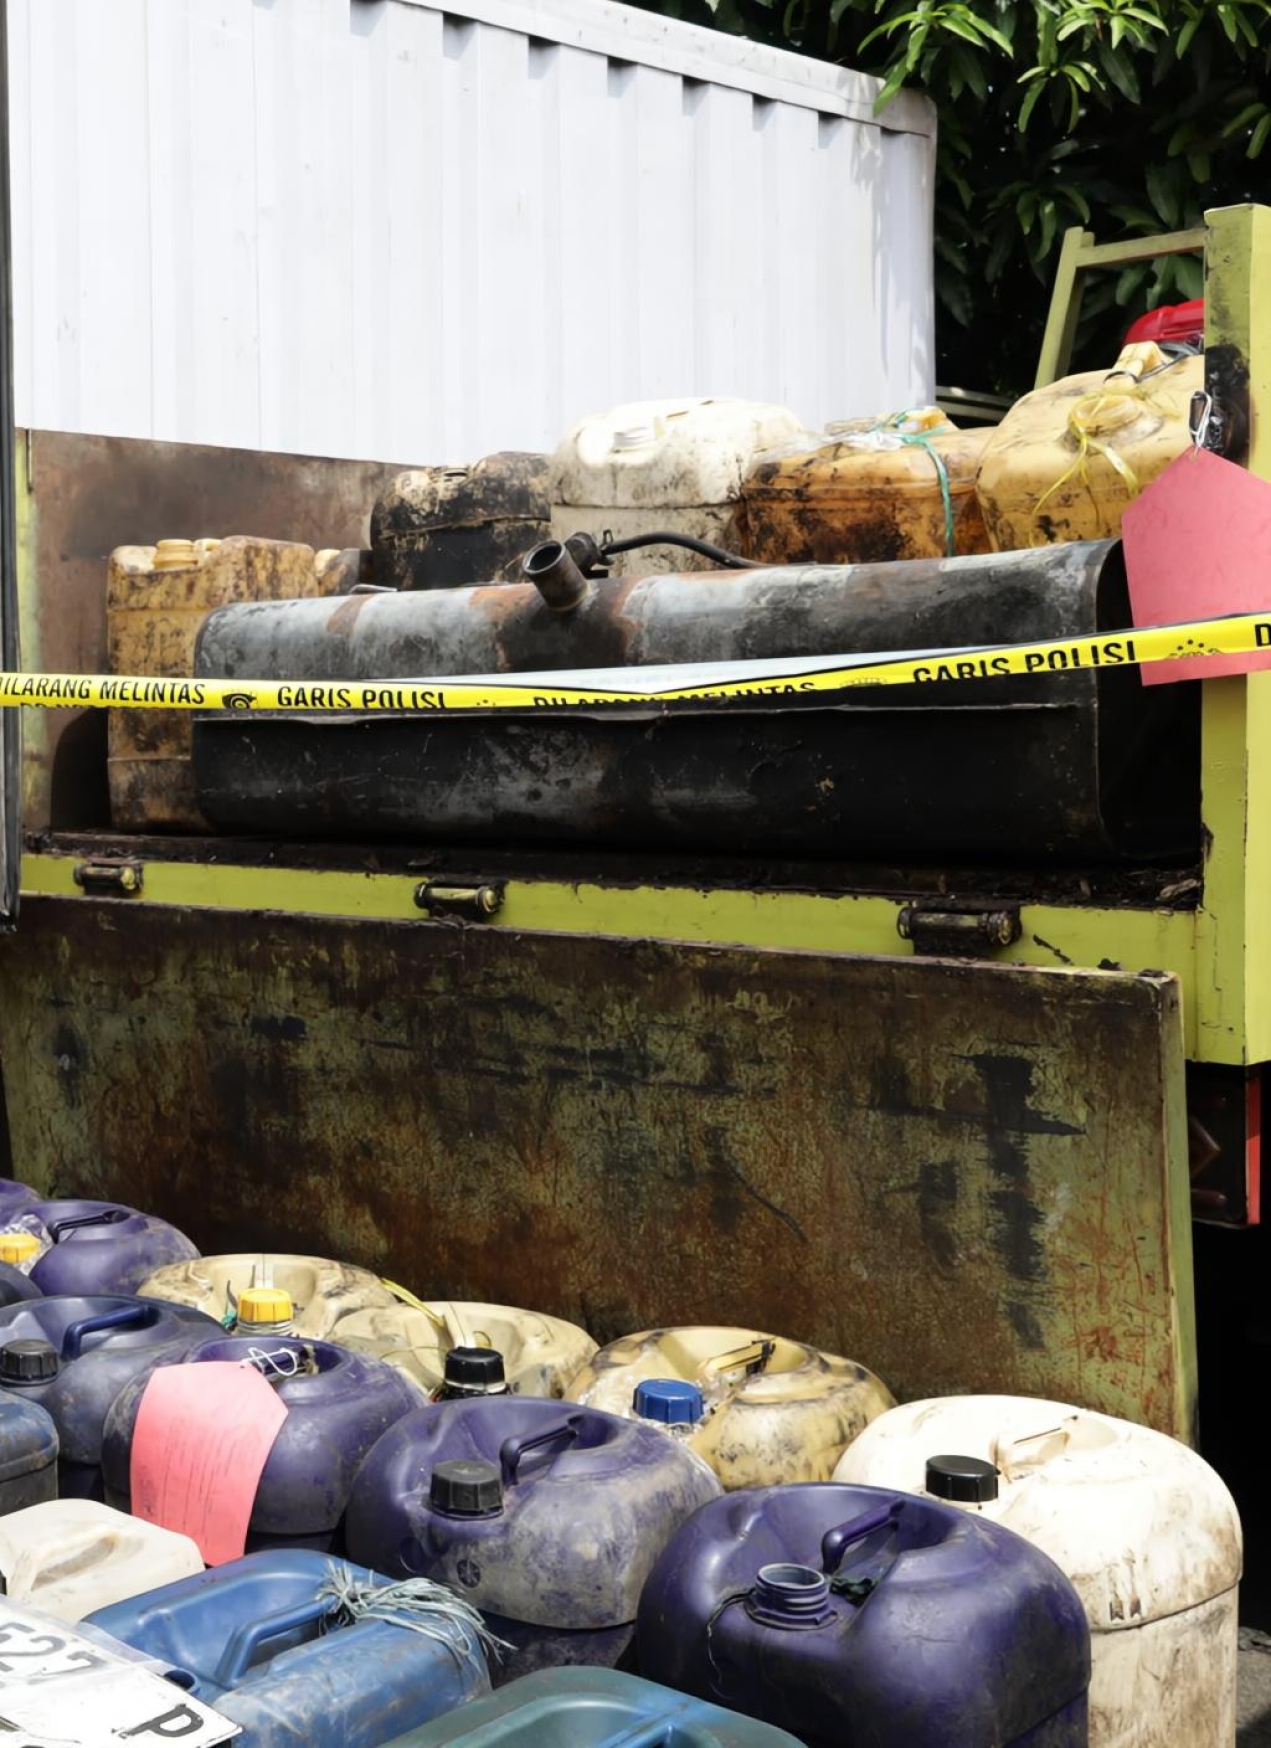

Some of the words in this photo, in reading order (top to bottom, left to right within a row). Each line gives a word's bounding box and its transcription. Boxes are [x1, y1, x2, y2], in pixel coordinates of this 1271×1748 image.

[912, 657, 1011, 683] GARIS
[1024, 640, 1136, 672] POLISI
[99, 680, 206, 705] MELINTAS
[277, 685, 351, 708] GARIS
[361, 688, 447, 709] POLISI
[125, 1702, 204, 1738] P
